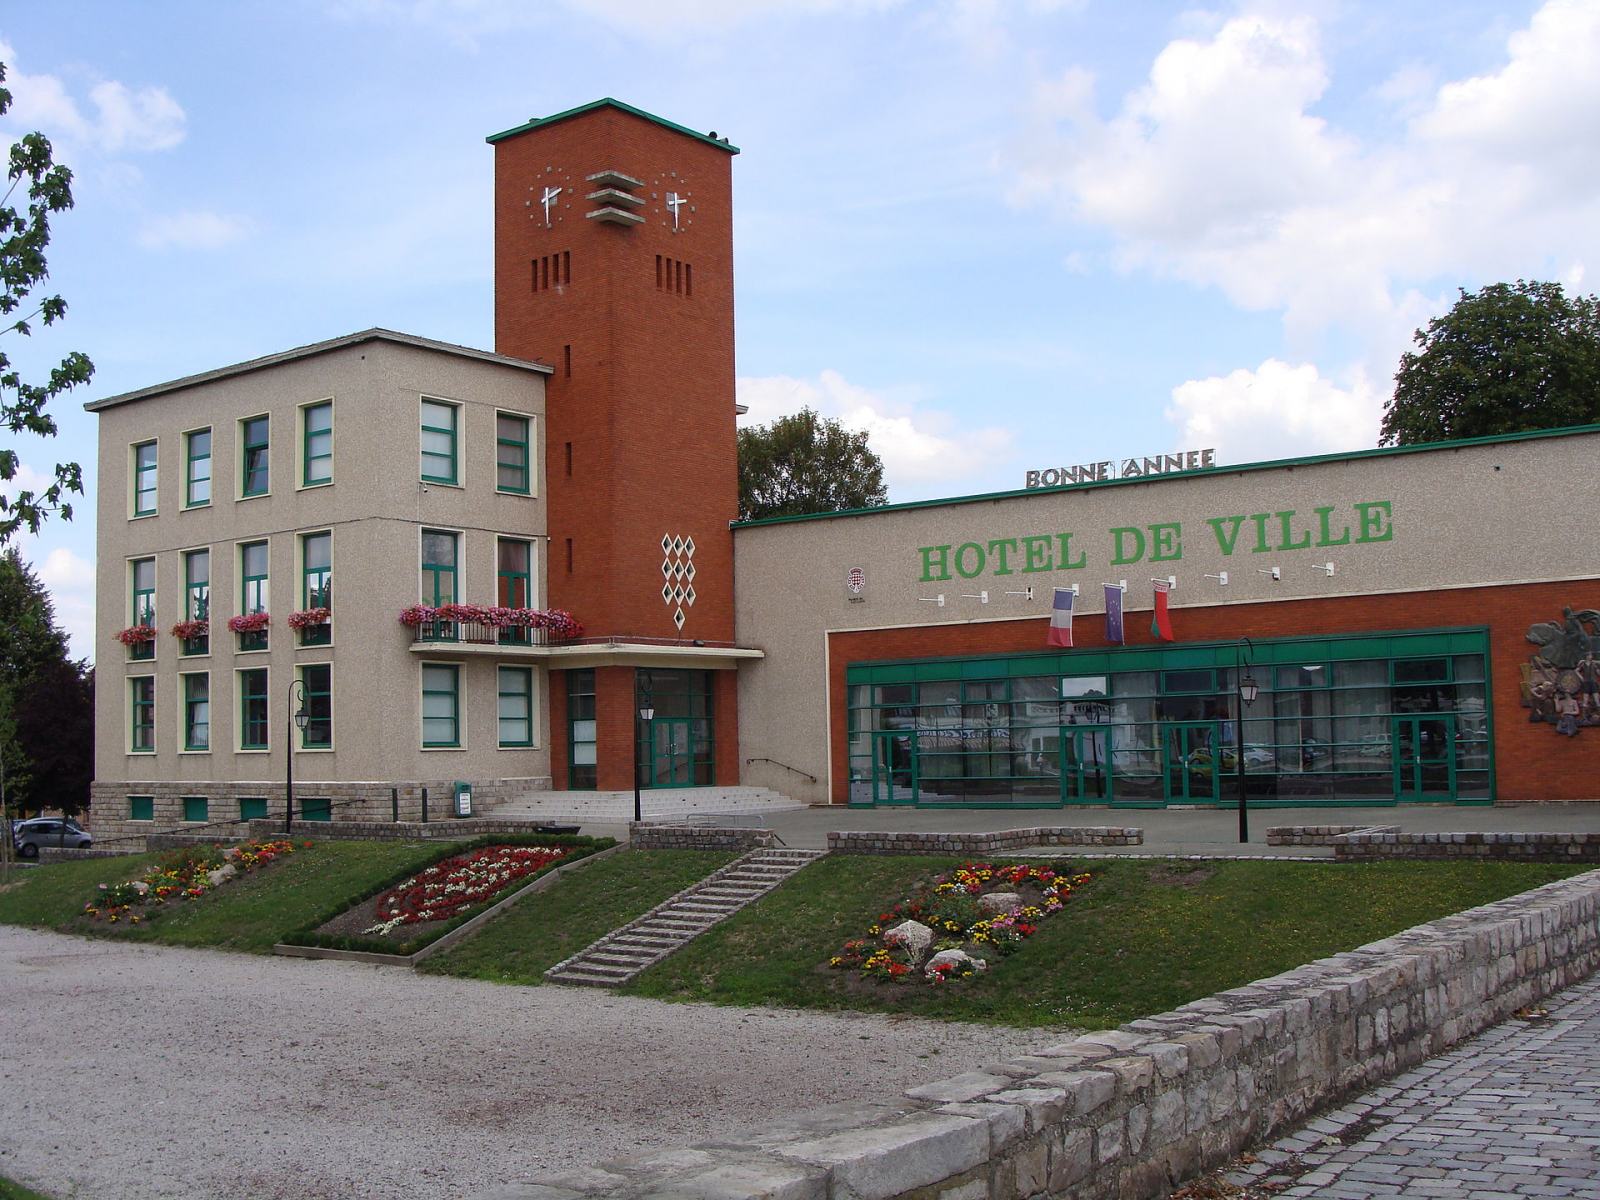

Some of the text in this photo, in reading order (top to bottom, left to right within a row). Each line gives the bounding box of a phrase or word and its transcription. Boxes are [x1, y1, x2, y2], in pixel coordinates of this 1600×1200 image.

[1026, 448, 1215, 489] BONNE ANNEE
[918, 500, 1394, 583] HOTEL DE VILLE
